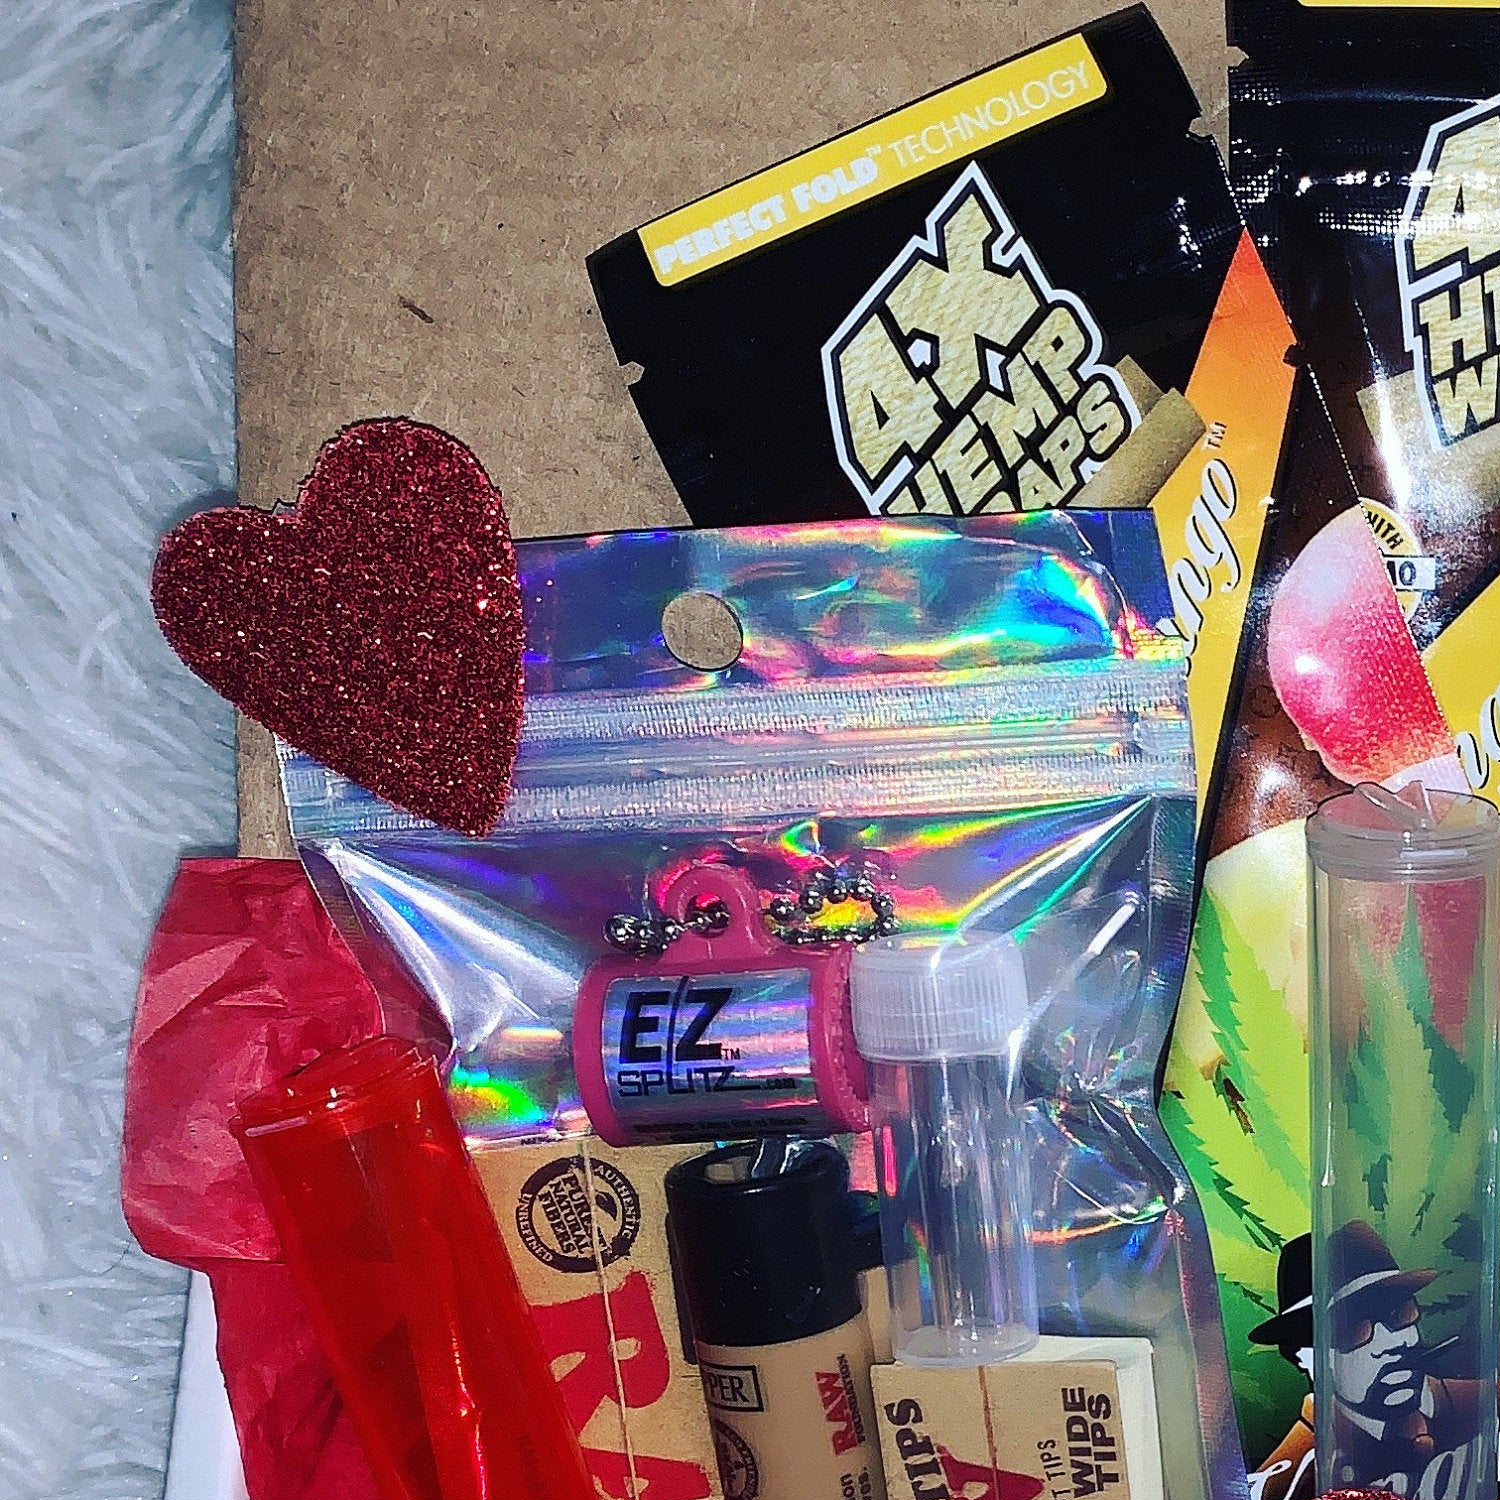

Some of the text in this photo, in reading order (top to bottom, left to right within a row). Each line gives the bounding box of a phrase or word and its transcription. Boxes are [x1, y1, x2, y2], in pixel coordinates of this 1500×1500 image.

[654, 194, 787, 275] PERFECT
[887, 59, 1090, 168] TECHNOLOGY
[836, 190, 1044, 484] 4X
[1037, 1437, 1068, 1482] TIPS
[1060, 1386, 1101, 1499] WIDE
[1088, 1391, 1121, 1493] TIPS
